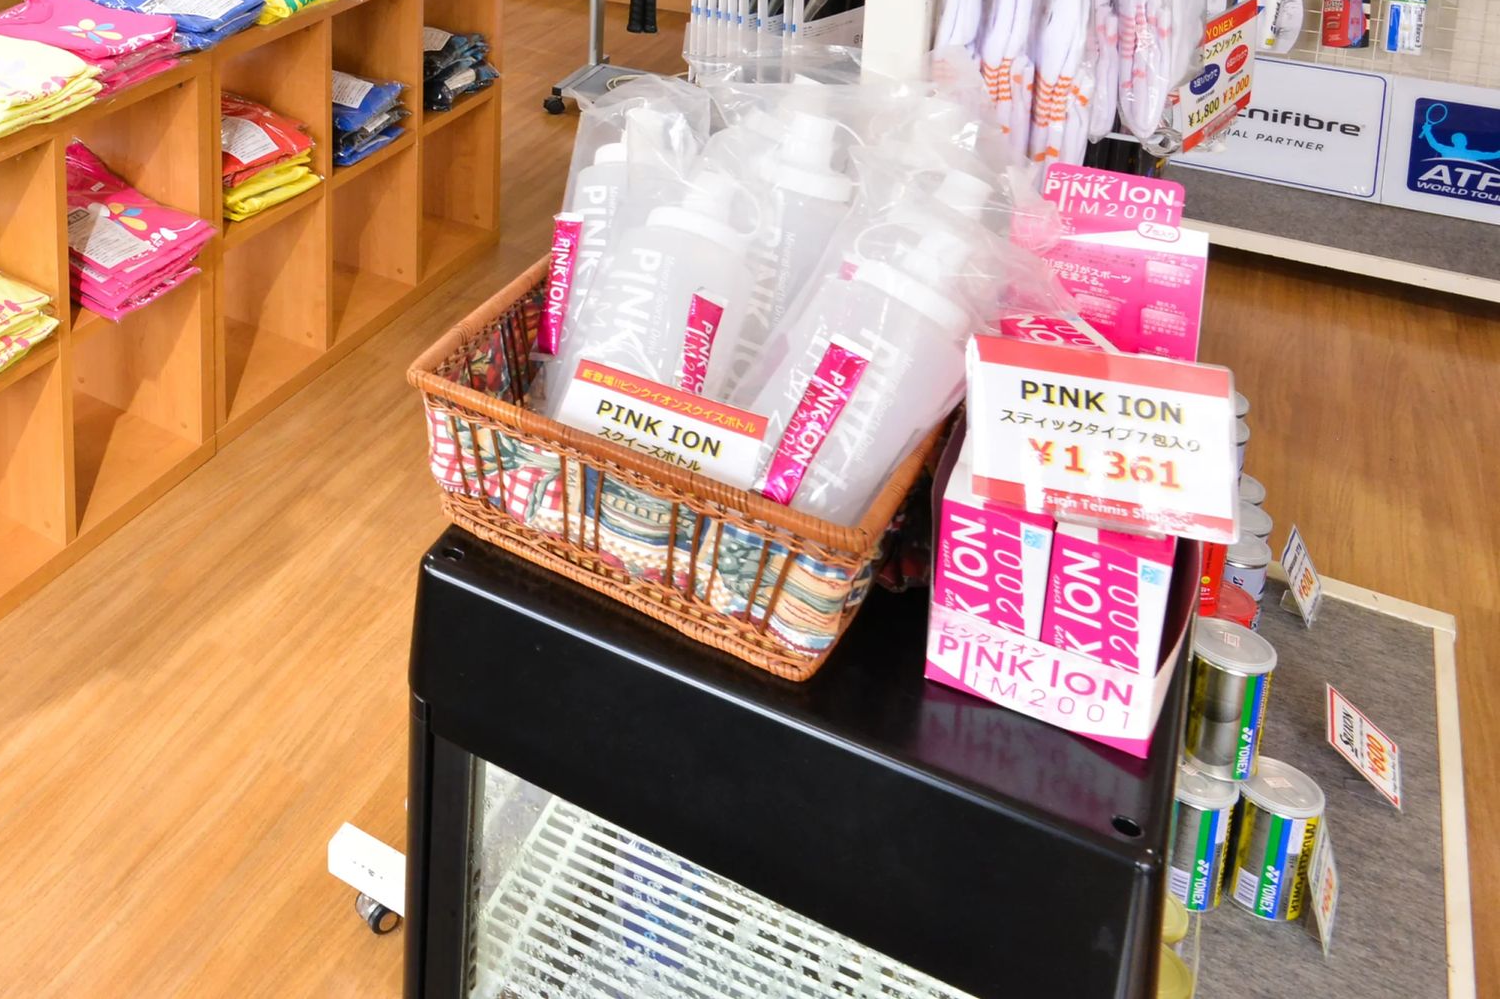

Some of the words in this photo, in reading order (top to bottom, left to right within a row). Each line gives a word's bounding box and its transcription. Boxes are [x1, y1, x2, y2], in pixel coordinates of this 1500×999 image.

[1206, 17, 1234, 38] YONEX
[1222, 74, 1250, 105] ¥3,000
[1187, 98, 1220, 128] ¥1,800
[1236, 107, 1361, 137] nifibre
[1256, 133, 1325, 152] PARTNER
[1045, 178, 1111, 213] PINK
[1119, 181, 1175, 207] ION
[1049, 171, 1120, 184] ピンクイオン
[1416, 180, 1468, 198] WORLD
[1067, 200, 1173, 223] IM2001
[552, 236, 572, 277] PINK
[548, 279, 569, 317] ION
[690, 319, 714, 374] PINK
[812, 368, 850, 423] PINK
[1020, 379, 1106, 413] PINK
[1117, 394, 1183, 425] ION
[595, 398, 659, 438] PINK
[668, 423, 723, 458] ION
[598, 424, 702, 472] スクイーズボトル
[1081, 498, 1129, 517] Tennis
[943, 513, 990, 592] ION
[1053, 547, 1102, 630] ION
[941, 621, 1047, 659] ピンクイオン
[937, 634, 1035, 684] PINK
[1049, 658, 1134, 708] ION
[972, 670, 1130, 730] IM2001
[1235, 741, 1251, 776] YONEX
[1366, 732, 1388, 781] ¥600
[1191, 875, 1209, 907] YONEX
[1258, 879, 1277, 914] YONEX
